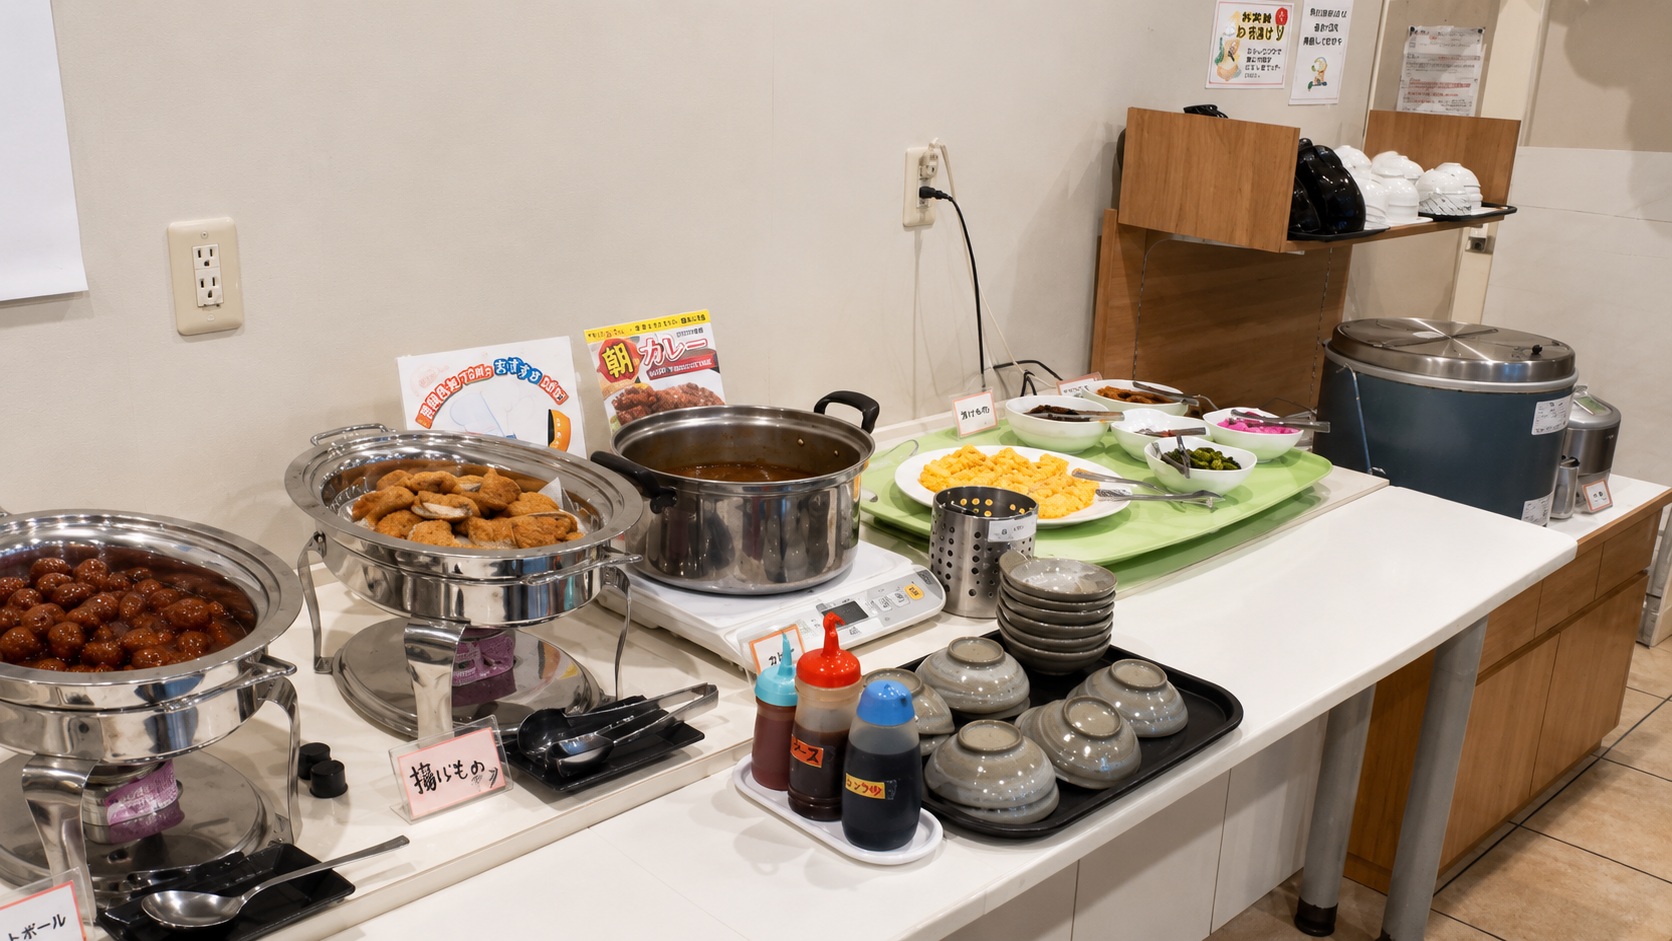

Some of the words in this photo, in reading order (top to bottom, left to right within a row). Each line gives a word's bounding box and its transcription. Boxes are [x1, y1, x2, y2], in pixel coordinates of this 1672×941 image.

[601, 342, 635, 379] 朝
[637, 336, 708, 367] カレー
[8, 914, 66, 941] トボール
